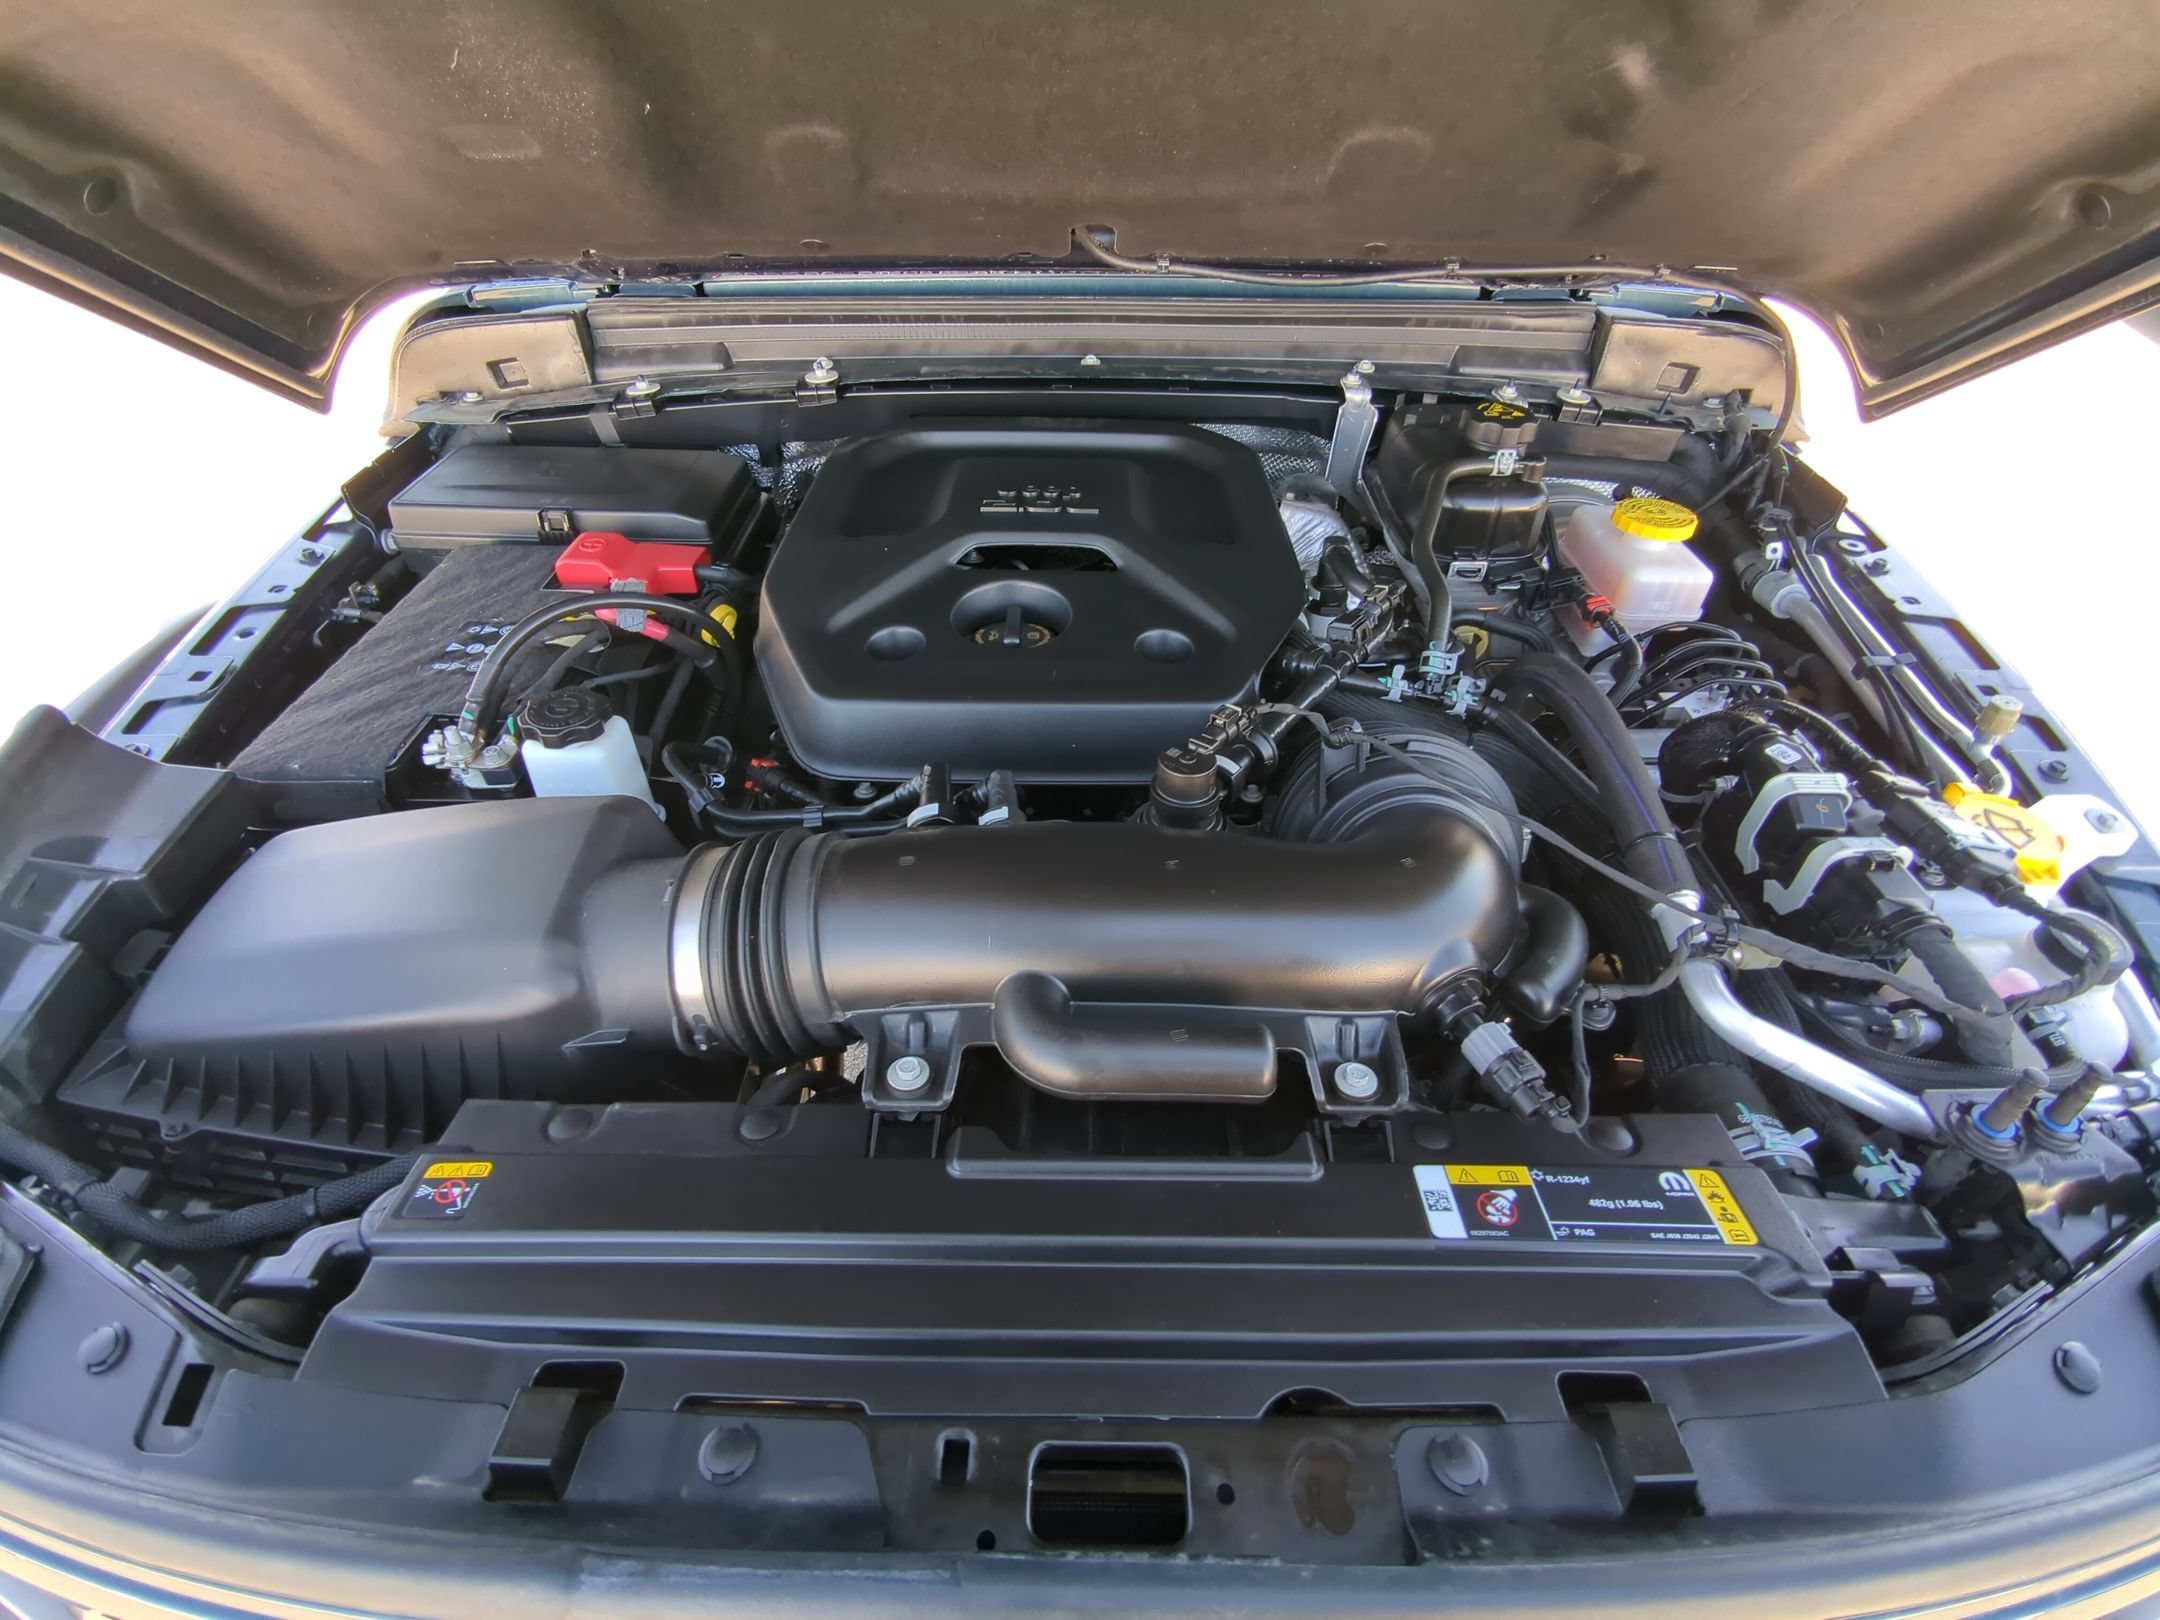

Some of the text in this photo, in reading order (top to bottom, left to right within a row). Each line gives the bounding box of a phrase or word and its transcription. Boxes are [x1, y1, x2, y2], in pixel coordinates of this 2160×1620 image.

[1545, 1175, 1591, 1185] R-1234yf
[1642, 1199, 1664, 1211] lbs)
[1573, 1228, 1596, 1237] PAG
